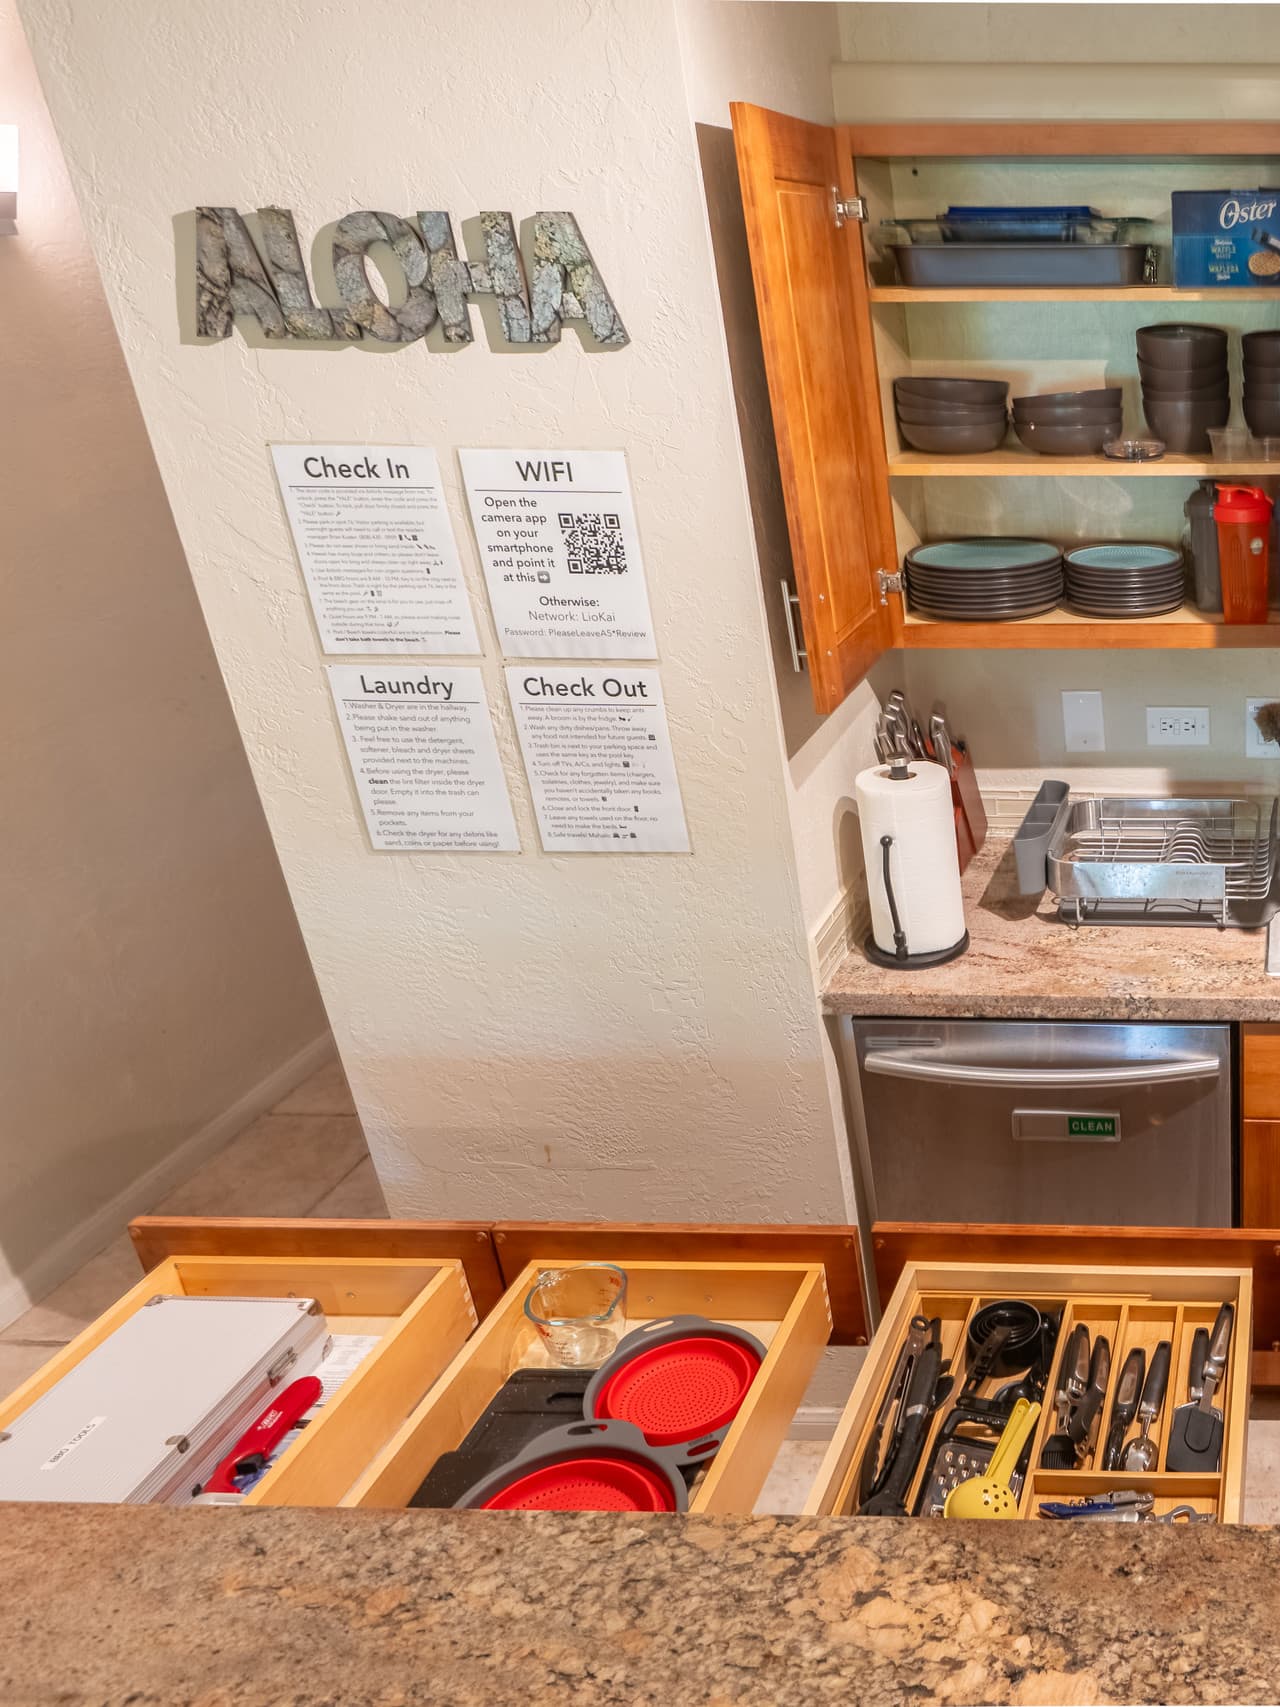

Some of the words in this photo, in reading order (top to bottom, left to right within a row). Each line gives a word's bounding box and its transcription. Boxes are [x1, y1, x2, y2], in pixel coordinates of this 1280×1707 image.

[1220, 200, 1277, 229] Oster
[197, 206, 630, 343] ALOHA
[304, 456, 380, 478] Check
[387, 458, 410, 478] In
[516, 461, 573, 482] WIFI
[484, 497, 517, 509] Open
[519, 498, 537, 507] the
[481, 514, 522, 522] camera
[525, 516, 547, 525] app
[514, 530, 538, 540] your
[488, 544, 553, 554] smartphone
[493, 559, 513, 567] and
[517, 559, 544, 570] point
[548, 559, 555, 567] it
[504, 574, 514, 582] at
[517, 573, 536, 582] this
[539, 596, 600, 607] Otherwise:
[528, 611, 579, 622] Network:
[582, 612, 616, 622] LioKai
[504, 628, 546, 637] Password:
[360, 675, 453, 700] Laundry
[523, 677, 596, 697] Check
[602, 678, 648, 697] Out
[1072, 1121, 1112, 1132] CLEAN
